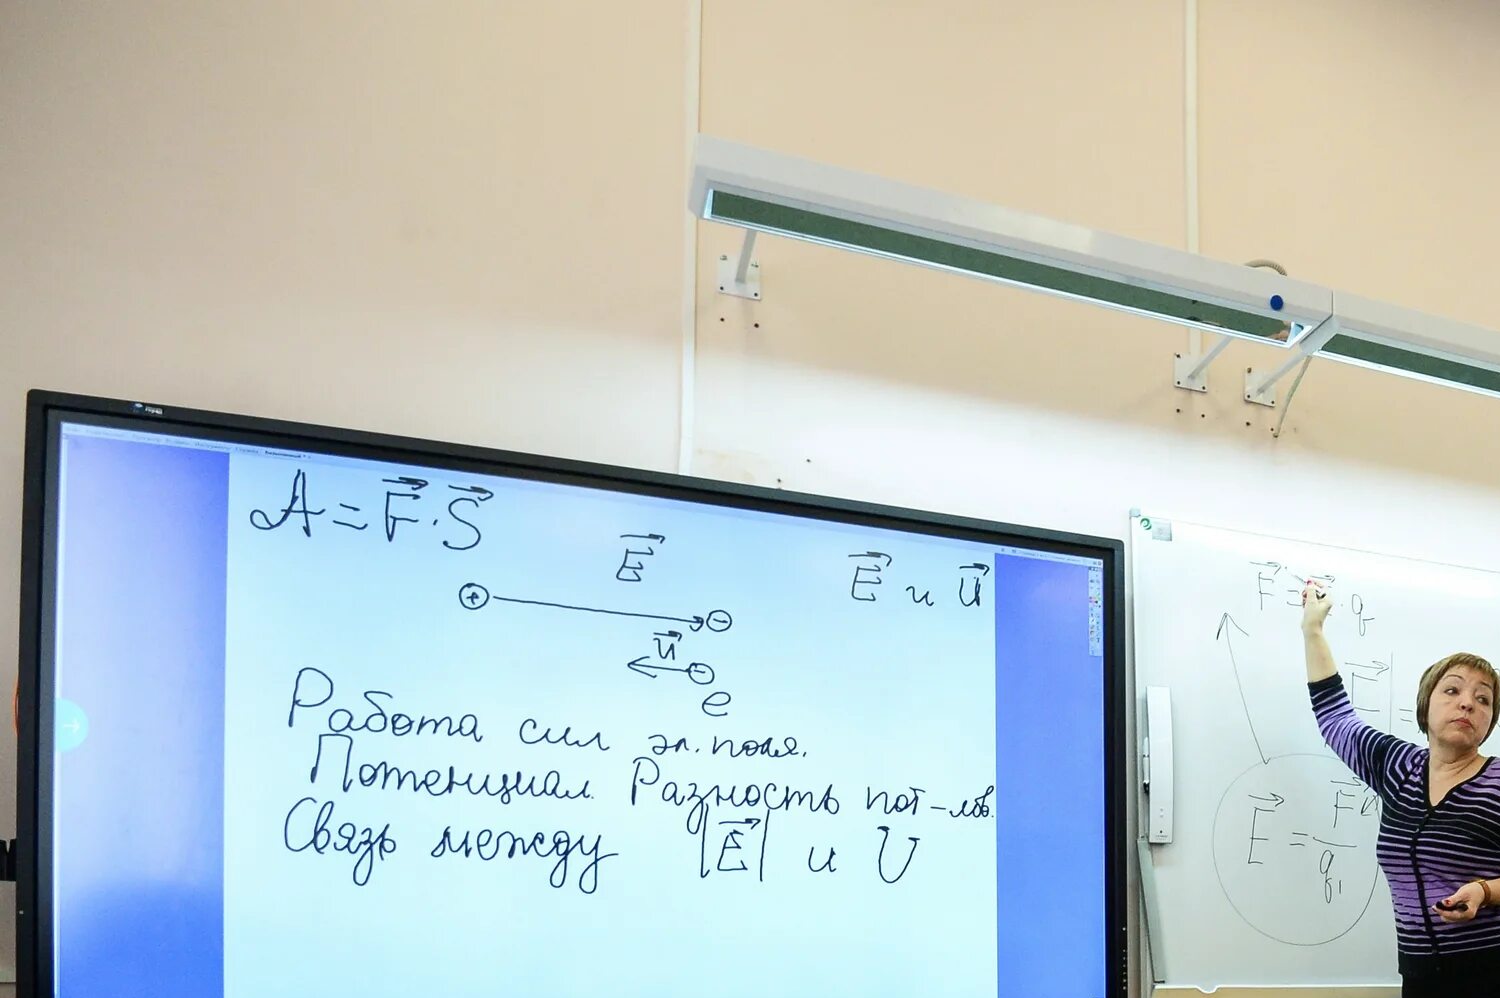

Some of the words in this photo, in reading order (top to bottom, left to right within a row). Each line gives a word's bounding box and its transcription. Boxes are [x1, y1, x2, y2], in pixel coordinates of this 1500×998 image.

[288, 667, 483, 742] Работа
[518, 718, 611, 751] сил
[631, 756, 840, 834] Разность
[284, 796, 397, 886] Связь
[430, 824, 620, 894] между
